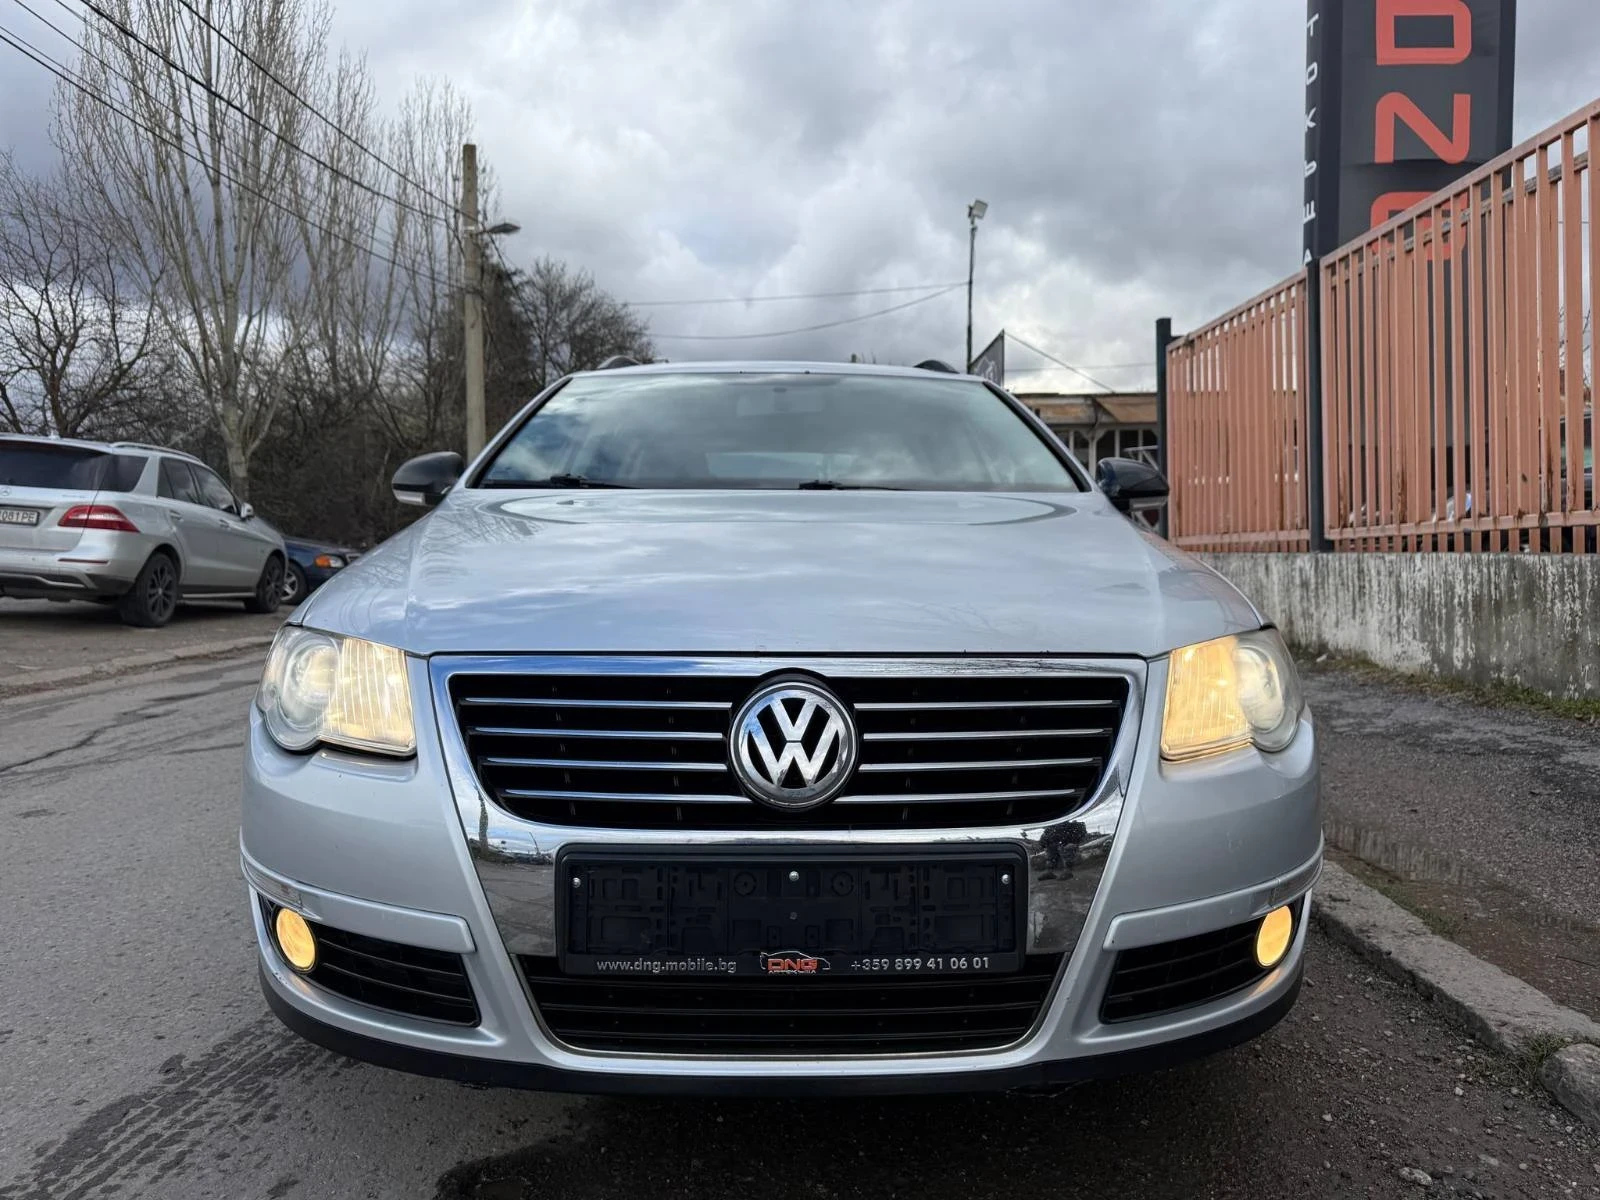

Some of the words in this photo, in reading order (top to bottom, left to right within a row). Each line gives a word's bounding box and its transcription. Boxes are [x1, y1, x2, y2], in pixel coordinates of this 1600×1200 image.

[0, 510, 35, 522] 081PE
[596, 957, 737, 973] www.dng.mobile.bg
[767, 958, 818, 970] DNG
[851, 958, 890, 971] +359
[894, 958, 922, 970] 899
[926, 957, 943, 969] 41
[950, 957, 968, 969] 06
[972, 957, 989, 969] 01
